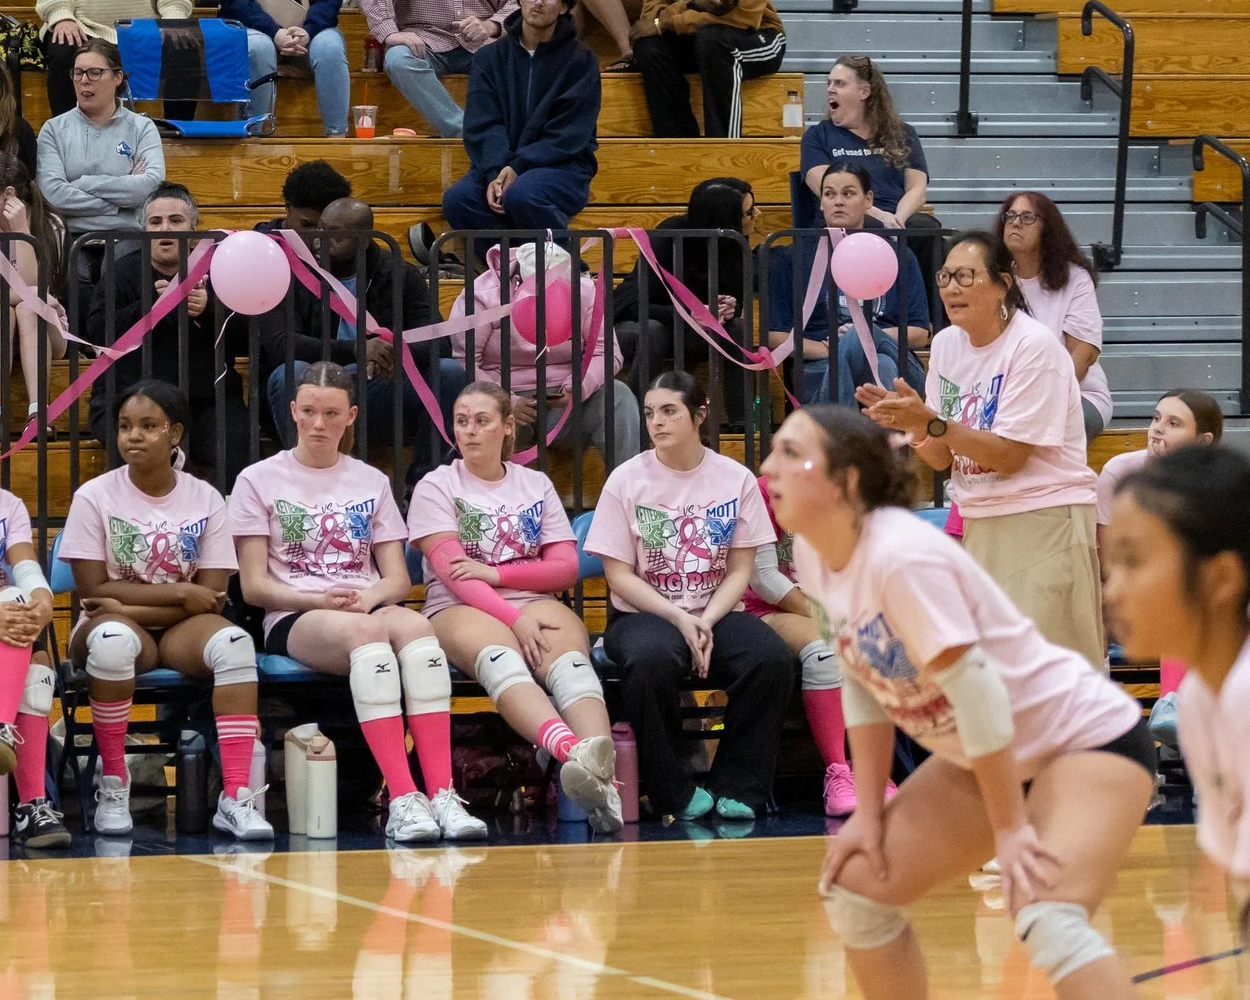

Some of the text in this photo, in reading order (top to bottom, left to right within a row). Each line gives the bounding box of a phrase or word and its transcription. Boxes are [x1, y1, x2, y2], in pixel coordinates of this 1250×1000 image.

[832, 148, 845, 157] Get
[321, 502, 334, 513] VS
[345, 498, 375, 514] MOTT
[494, 504, 508, 516] VS
[682, 504, 695, 517] VS
[706, 498, 738, 518] MOTT
[155, 520, 168, 532] VS
[645, 571, 683, 592] DIG
